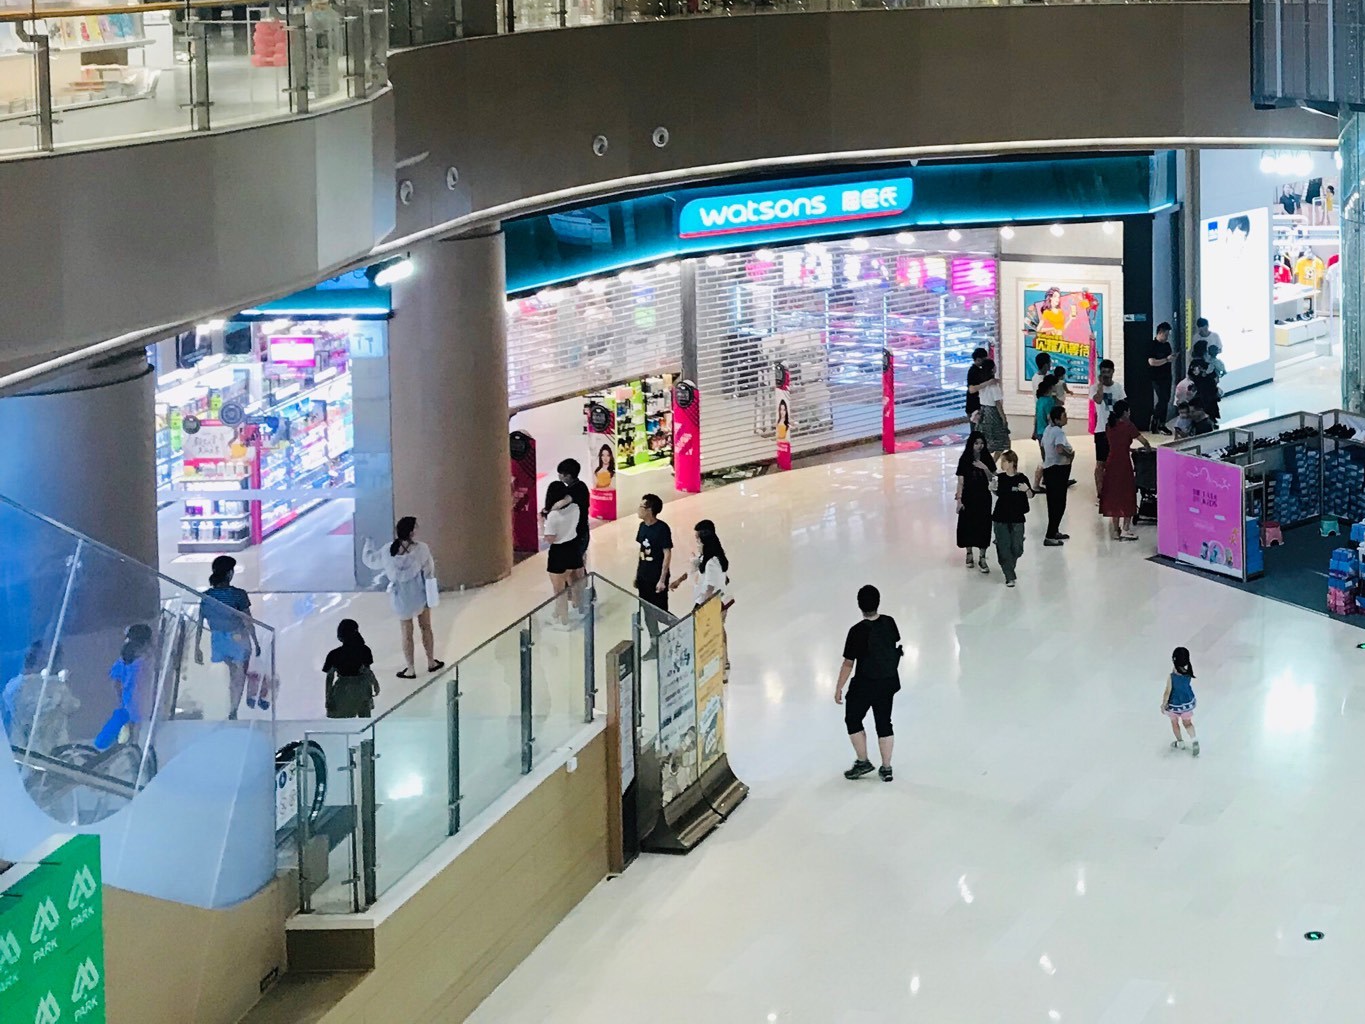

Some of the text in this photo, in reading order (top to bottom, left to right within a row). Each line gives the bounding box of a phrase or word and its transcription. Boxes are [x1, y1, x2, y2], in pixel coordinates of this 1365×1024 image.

[700, 195, 827, 226] watsons
[70, 906, 95, 930] PARK
[33, 937, 58, 964] PARK
[74, 995, 99, 1023] PARK
